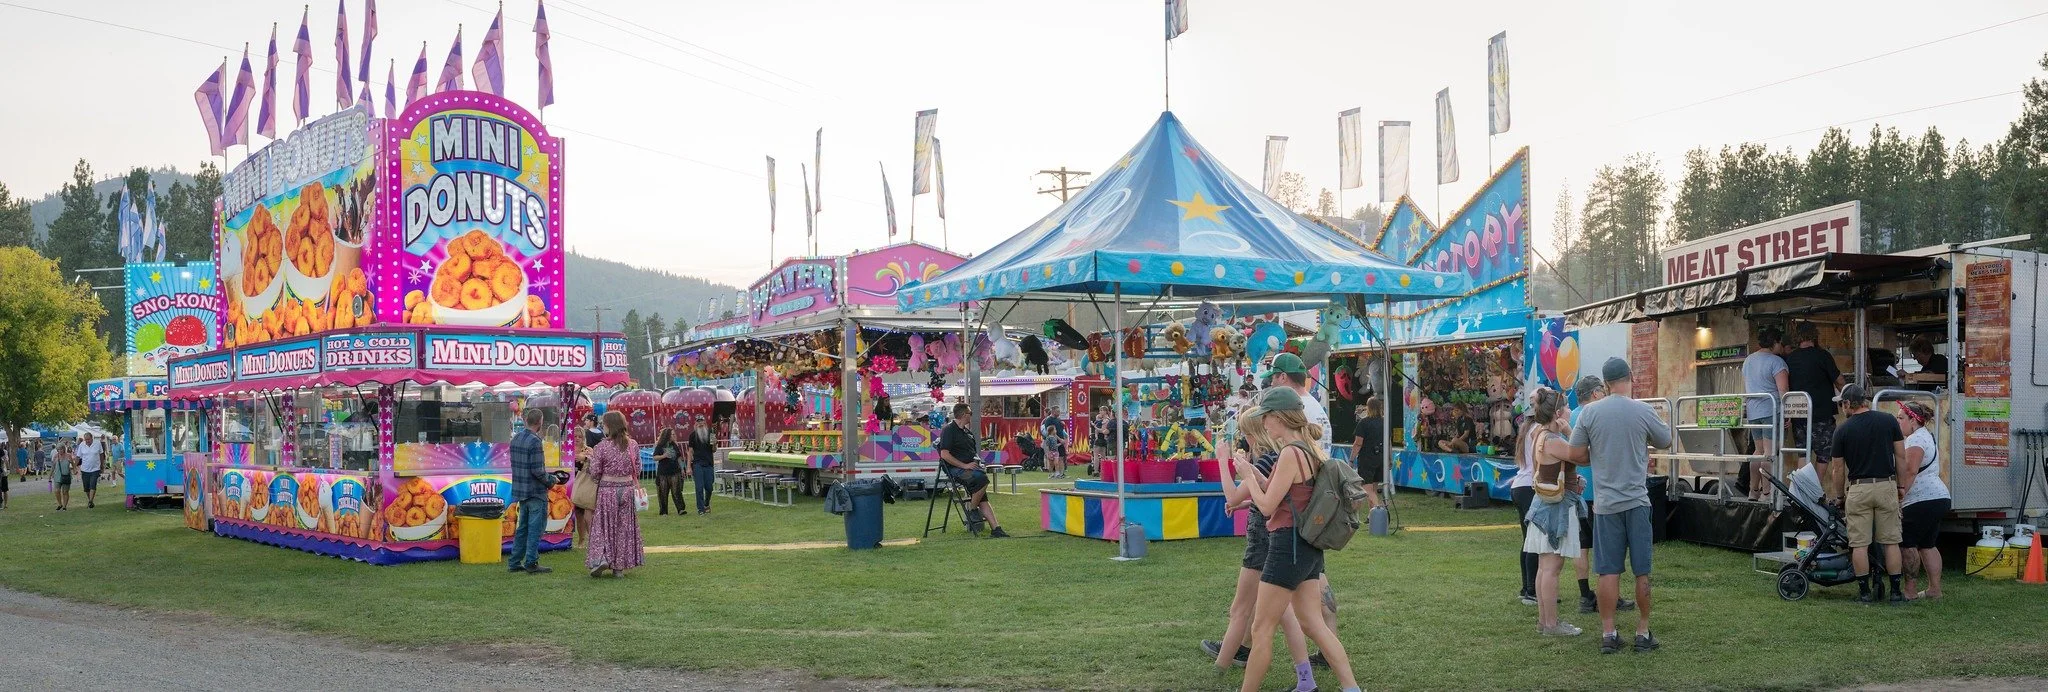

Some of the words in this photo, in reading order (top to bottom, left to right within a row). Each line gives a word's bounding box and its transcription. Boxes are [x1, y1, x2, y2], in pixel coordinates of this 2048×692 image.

[271, 110, 367, 191] DONUTS
[432, 116, 520, 171] MINI
[224, 149, 268, 222] MINI
[405, 171, 547, 249] DONUTS
[1417, 202, 1523, 273] CTORY
[1667, 244, 1730, 286] MEAT
[1737, 216, 1850, 270] STREET
[751, 263, 836, 320] WATER
[326, 348, 412, 366] DRINKS
[327, 339, 350, 349] HOT
[353, 338, 365, 348] &
[368, 337, 410, 347] COLD
[432, 339, 491, 365] MINI
[495, 340, 586, 367] DONUTS
[605, 342, 622, 351] HOT
[1701, 349, 1721, 359] SAUCY
[1722, 348, 1740, 357] ALLEY
[175, 365, 193, 384] MINI
[193, 360, 228, 381] DONUTS
[241, 353, 267, 376] MINI
[267, 347, 316, 373] DONUTS
[91, 384, 122, 398] SNO-KONES
[470, 482, 496, 495] MINI
